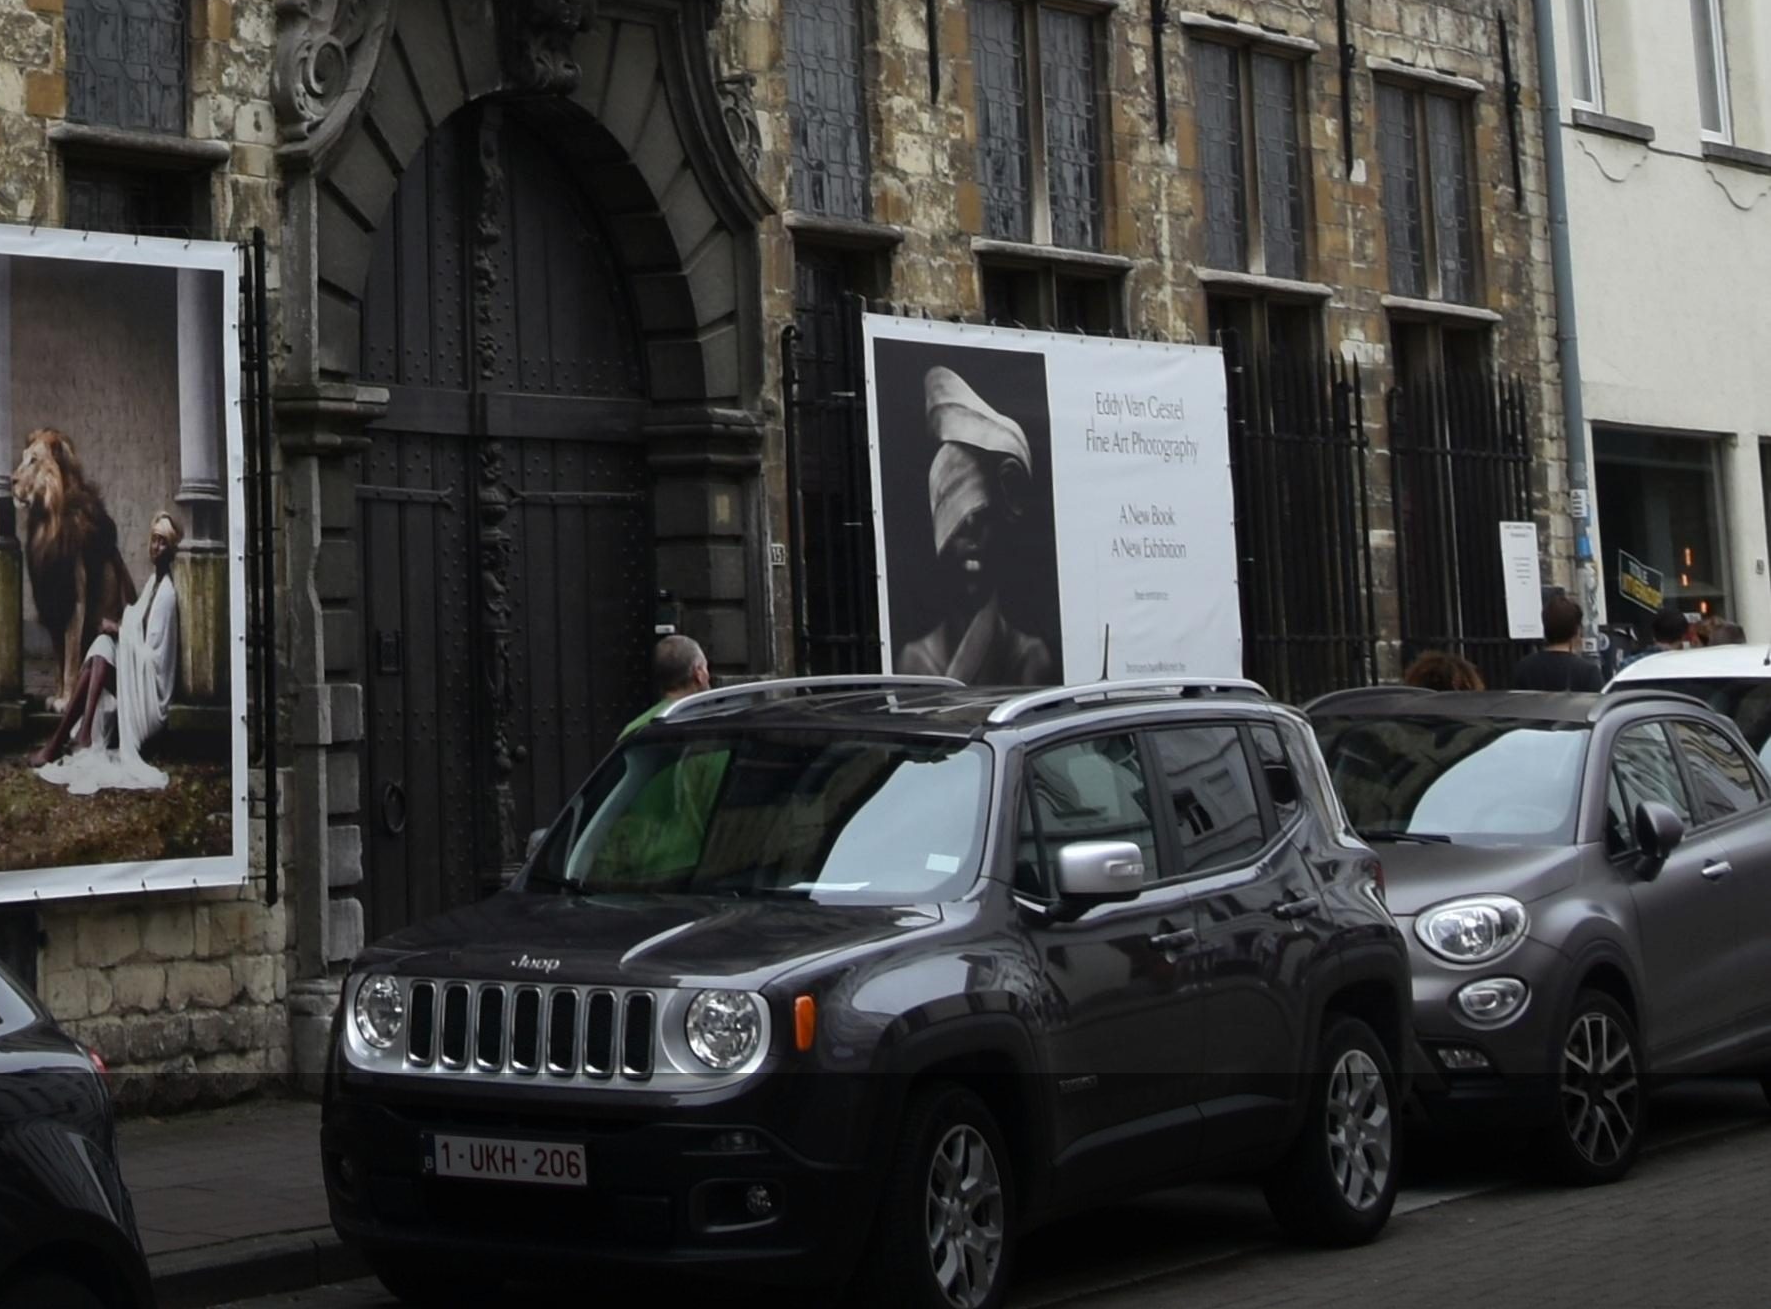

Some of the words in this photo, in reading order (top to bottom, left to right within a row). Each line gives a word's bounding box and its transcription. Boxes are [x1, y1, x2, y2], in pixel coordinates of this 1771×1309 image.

[1095, 392, 1123, 423] Eddy
[1124, 394, 1146, 419] Van
[1147, 395, 1184, 421] Gestel
[1086, 428, 1110, 453] Fine
[1113, 431, 1130, 454] Art
[1131, 431, 1198, 464] Photography
[1119, 506, 1127, 524] A
[1128, 505, 1150, 525] New
[1151, 506, 1176, 526] Book
[1111, 538, 1120, 558] A
[1120, 538, 1141, 558] New
[1143, 538, 1186, 559] Exhibition
[511, 954, 560, 973] Jeep
